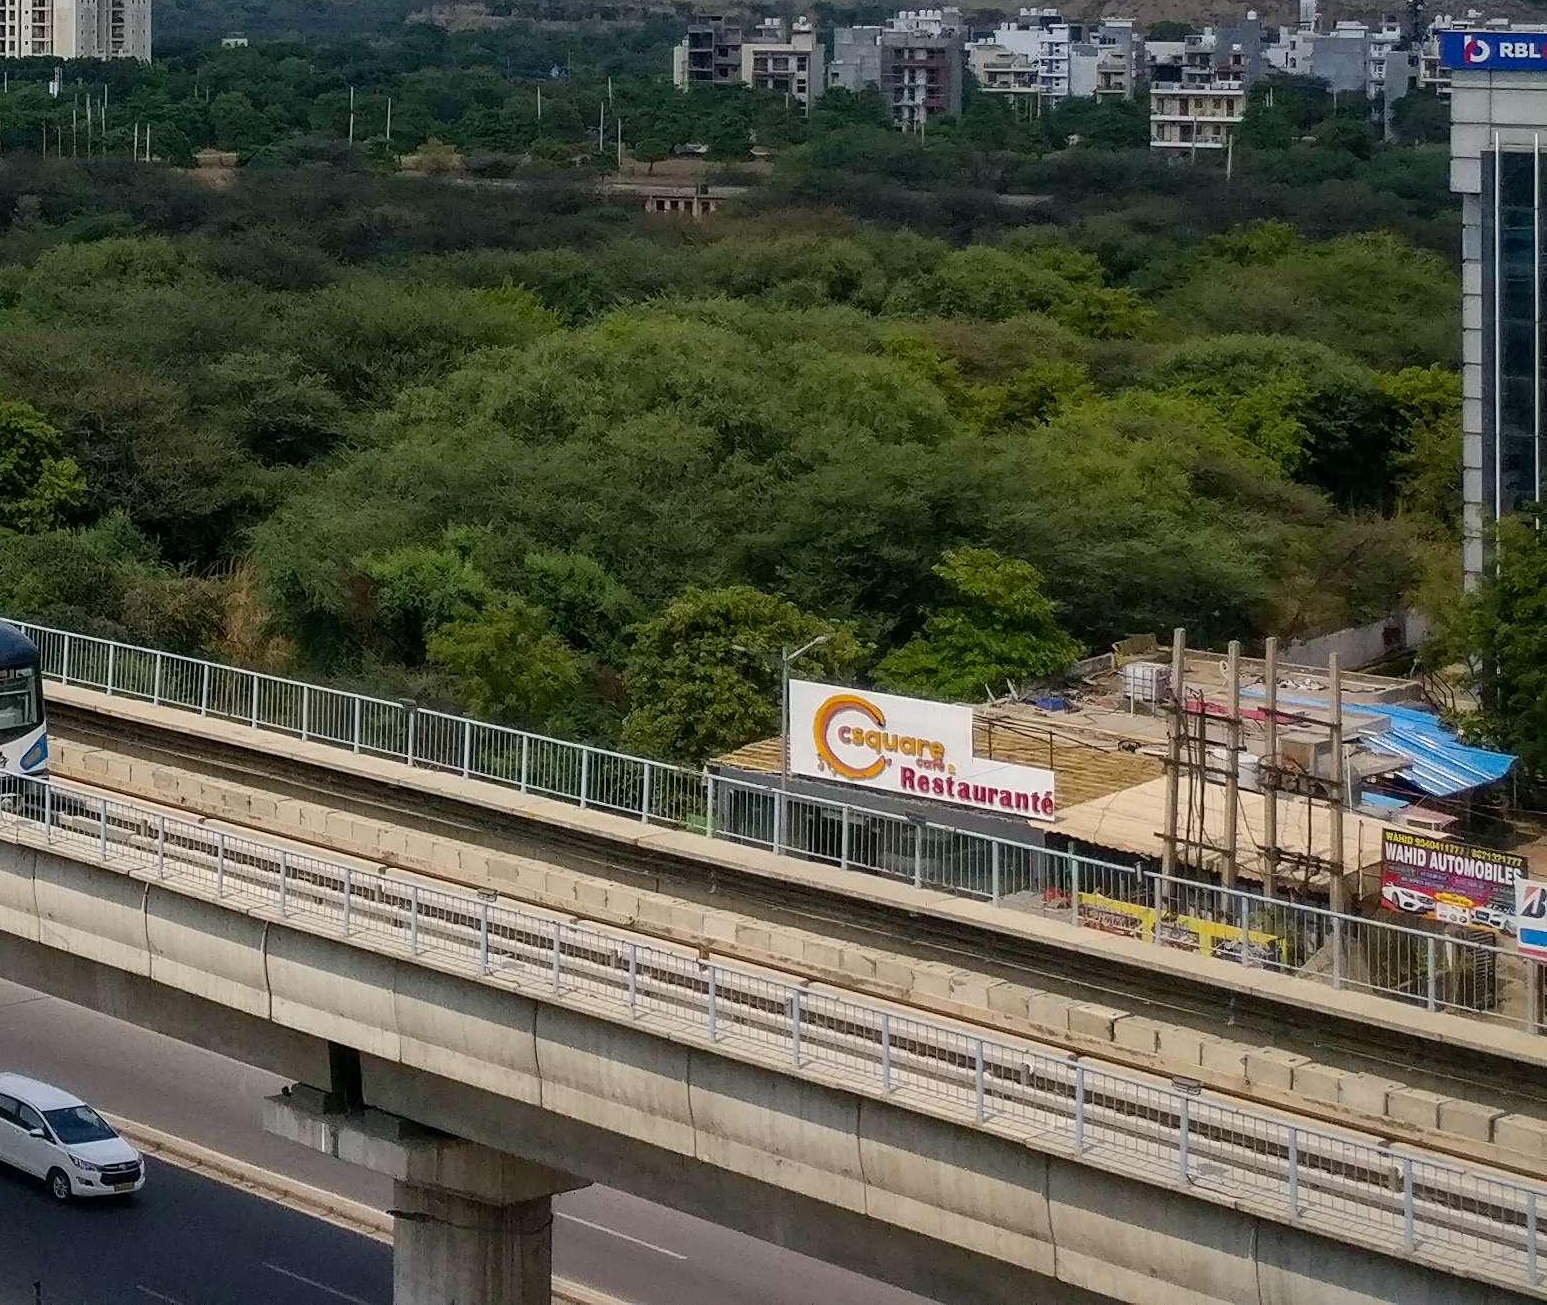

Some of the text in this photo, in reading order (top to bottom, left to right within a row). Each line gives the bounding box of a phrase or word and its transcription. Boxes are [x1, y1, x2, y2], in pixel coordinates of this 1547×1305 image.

[1499, 42, 1541, 58] RBL
[900, 765, 1055, 815] Restauranté
[1386, 831, 1414, 845] WAHID
[1385, 842, 1426, 867] WAHID
